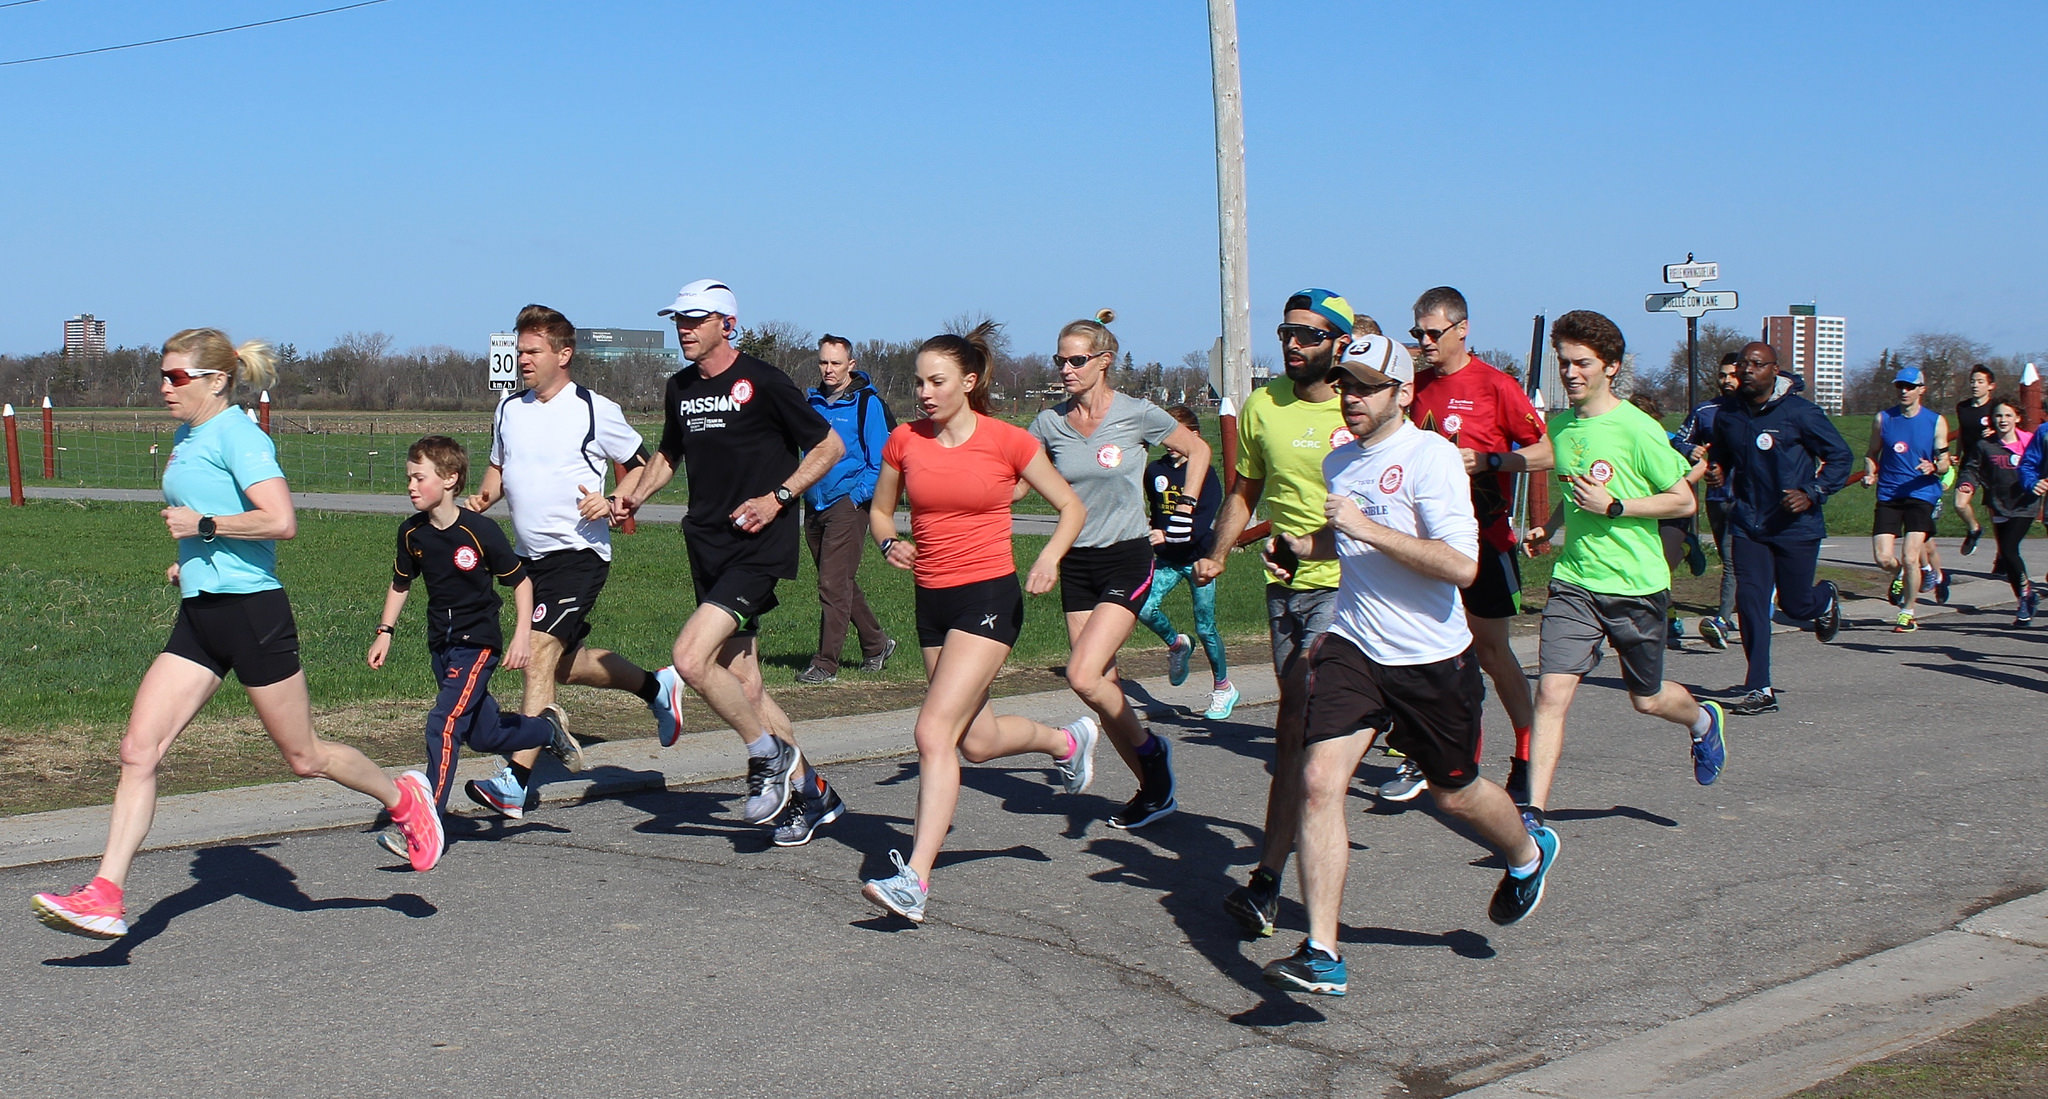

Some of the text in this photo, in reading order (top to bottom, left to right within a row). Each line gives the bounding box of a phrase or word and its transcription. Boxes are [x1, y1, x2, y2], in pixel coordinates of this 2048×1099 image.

[1663, 296, 1718, 308] RUELLE COW LANE
[492, 353, 513, 373] 30
[680, 395, 740, 416] PASSION
[1292, 439, 1321, 449] OCRC
